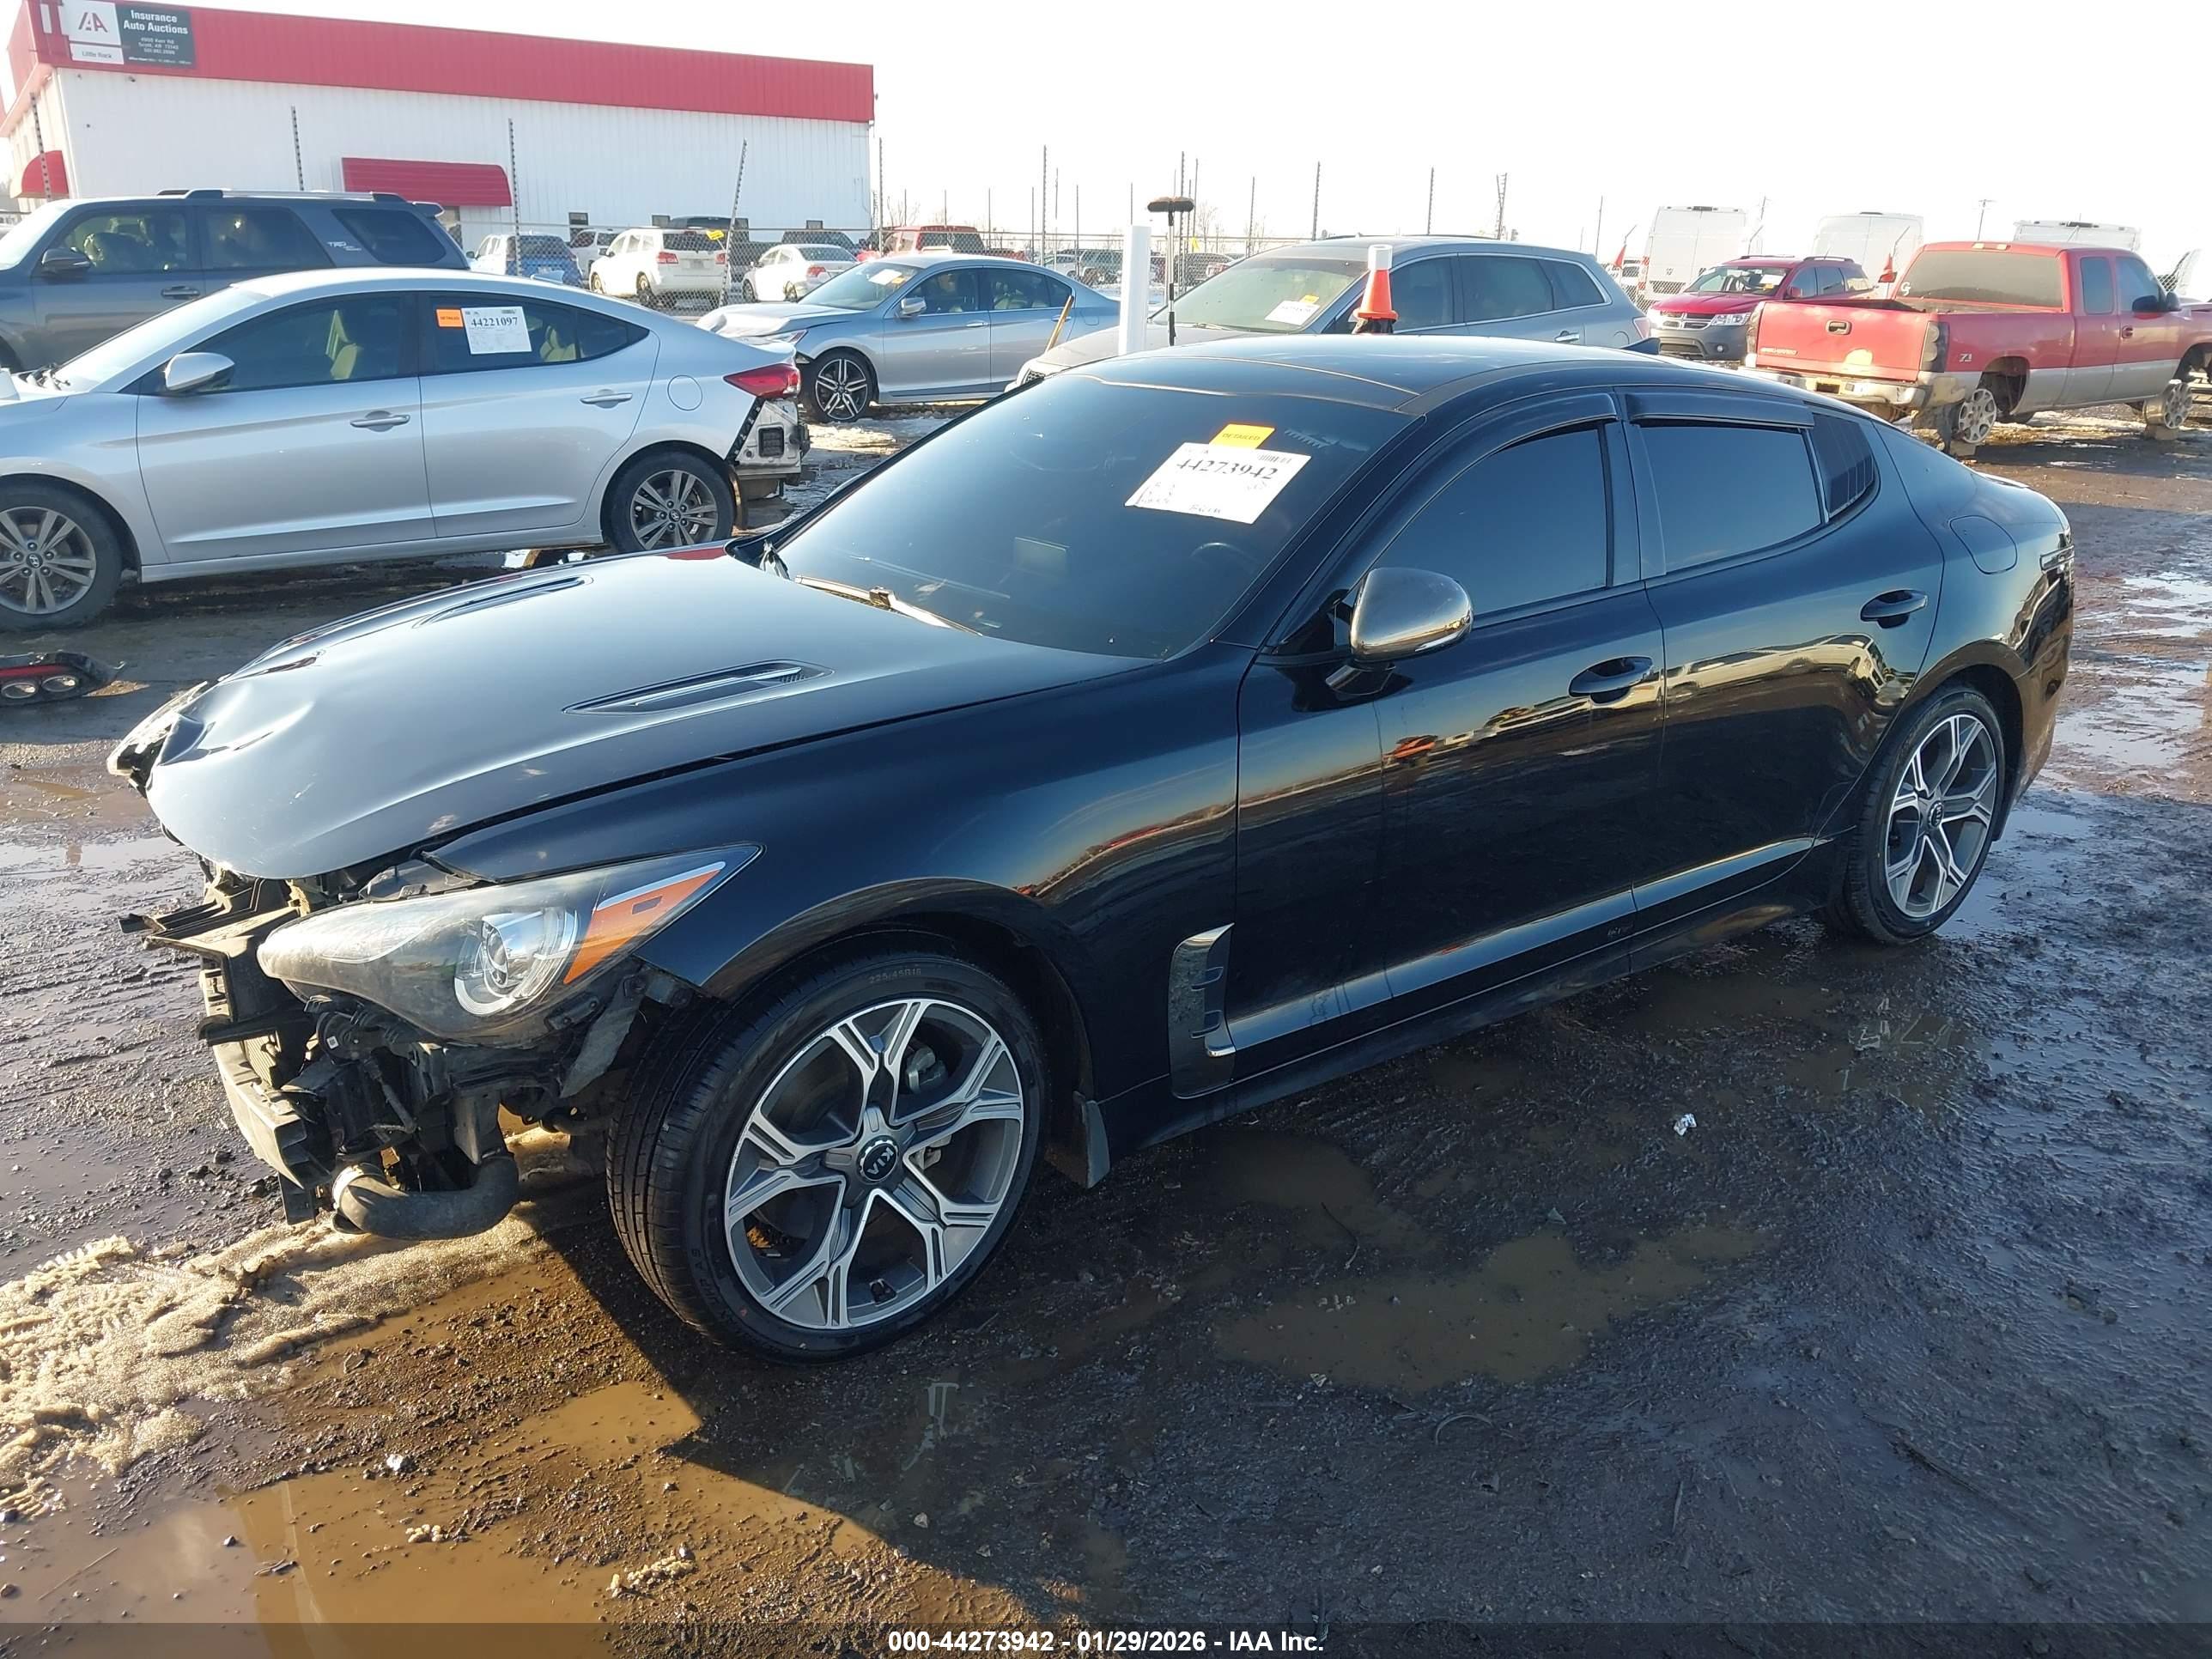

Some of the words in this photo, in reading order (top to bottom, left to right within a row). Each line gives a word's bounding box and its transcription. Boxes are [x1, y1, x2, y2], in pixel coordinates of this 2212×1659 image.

[131, 9, 177, 23] Insurance
[123, 20, 145, 31] Auto
[148, 22, 188, 35] Auctions
[471, 317, 518, 327] 44221097
[1222, 433, 1261, 441] DETAILED
[1176, 459, 1279, 480] 44273942
[866, 1146, 895, 1175] KIA
